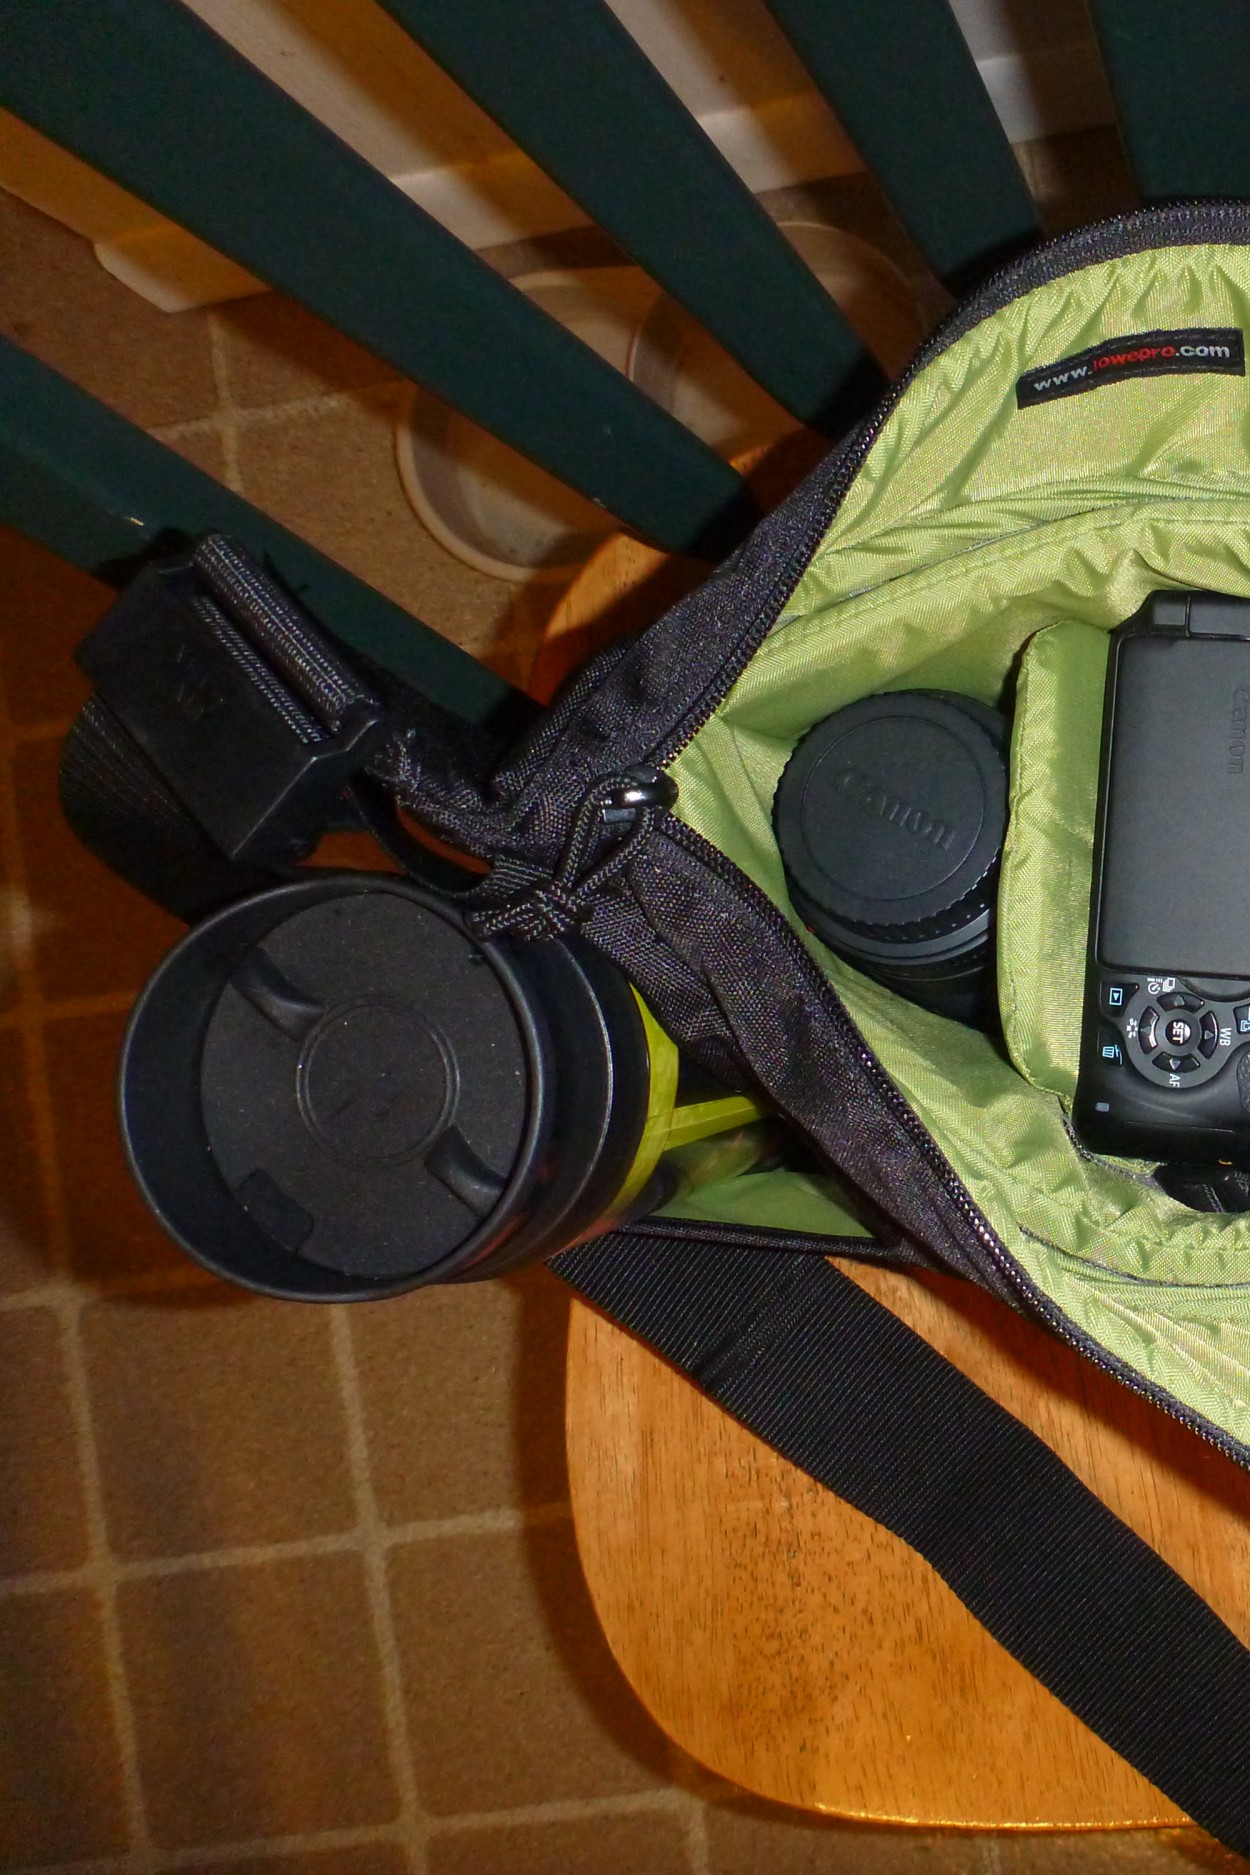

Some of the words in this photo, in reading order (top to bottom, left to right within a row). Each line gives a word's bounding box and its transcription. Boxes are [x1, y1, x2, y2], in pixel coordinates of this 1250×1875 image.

[1033, 344, 1230, 391] www.lowepro.com
[834, 767, 955, 850] Canon
[1172, 1021, 1185, 1043] SET
[1219, 1027, 1231, 1046] WB
[1168, 1073, 1180, 1087] AF
